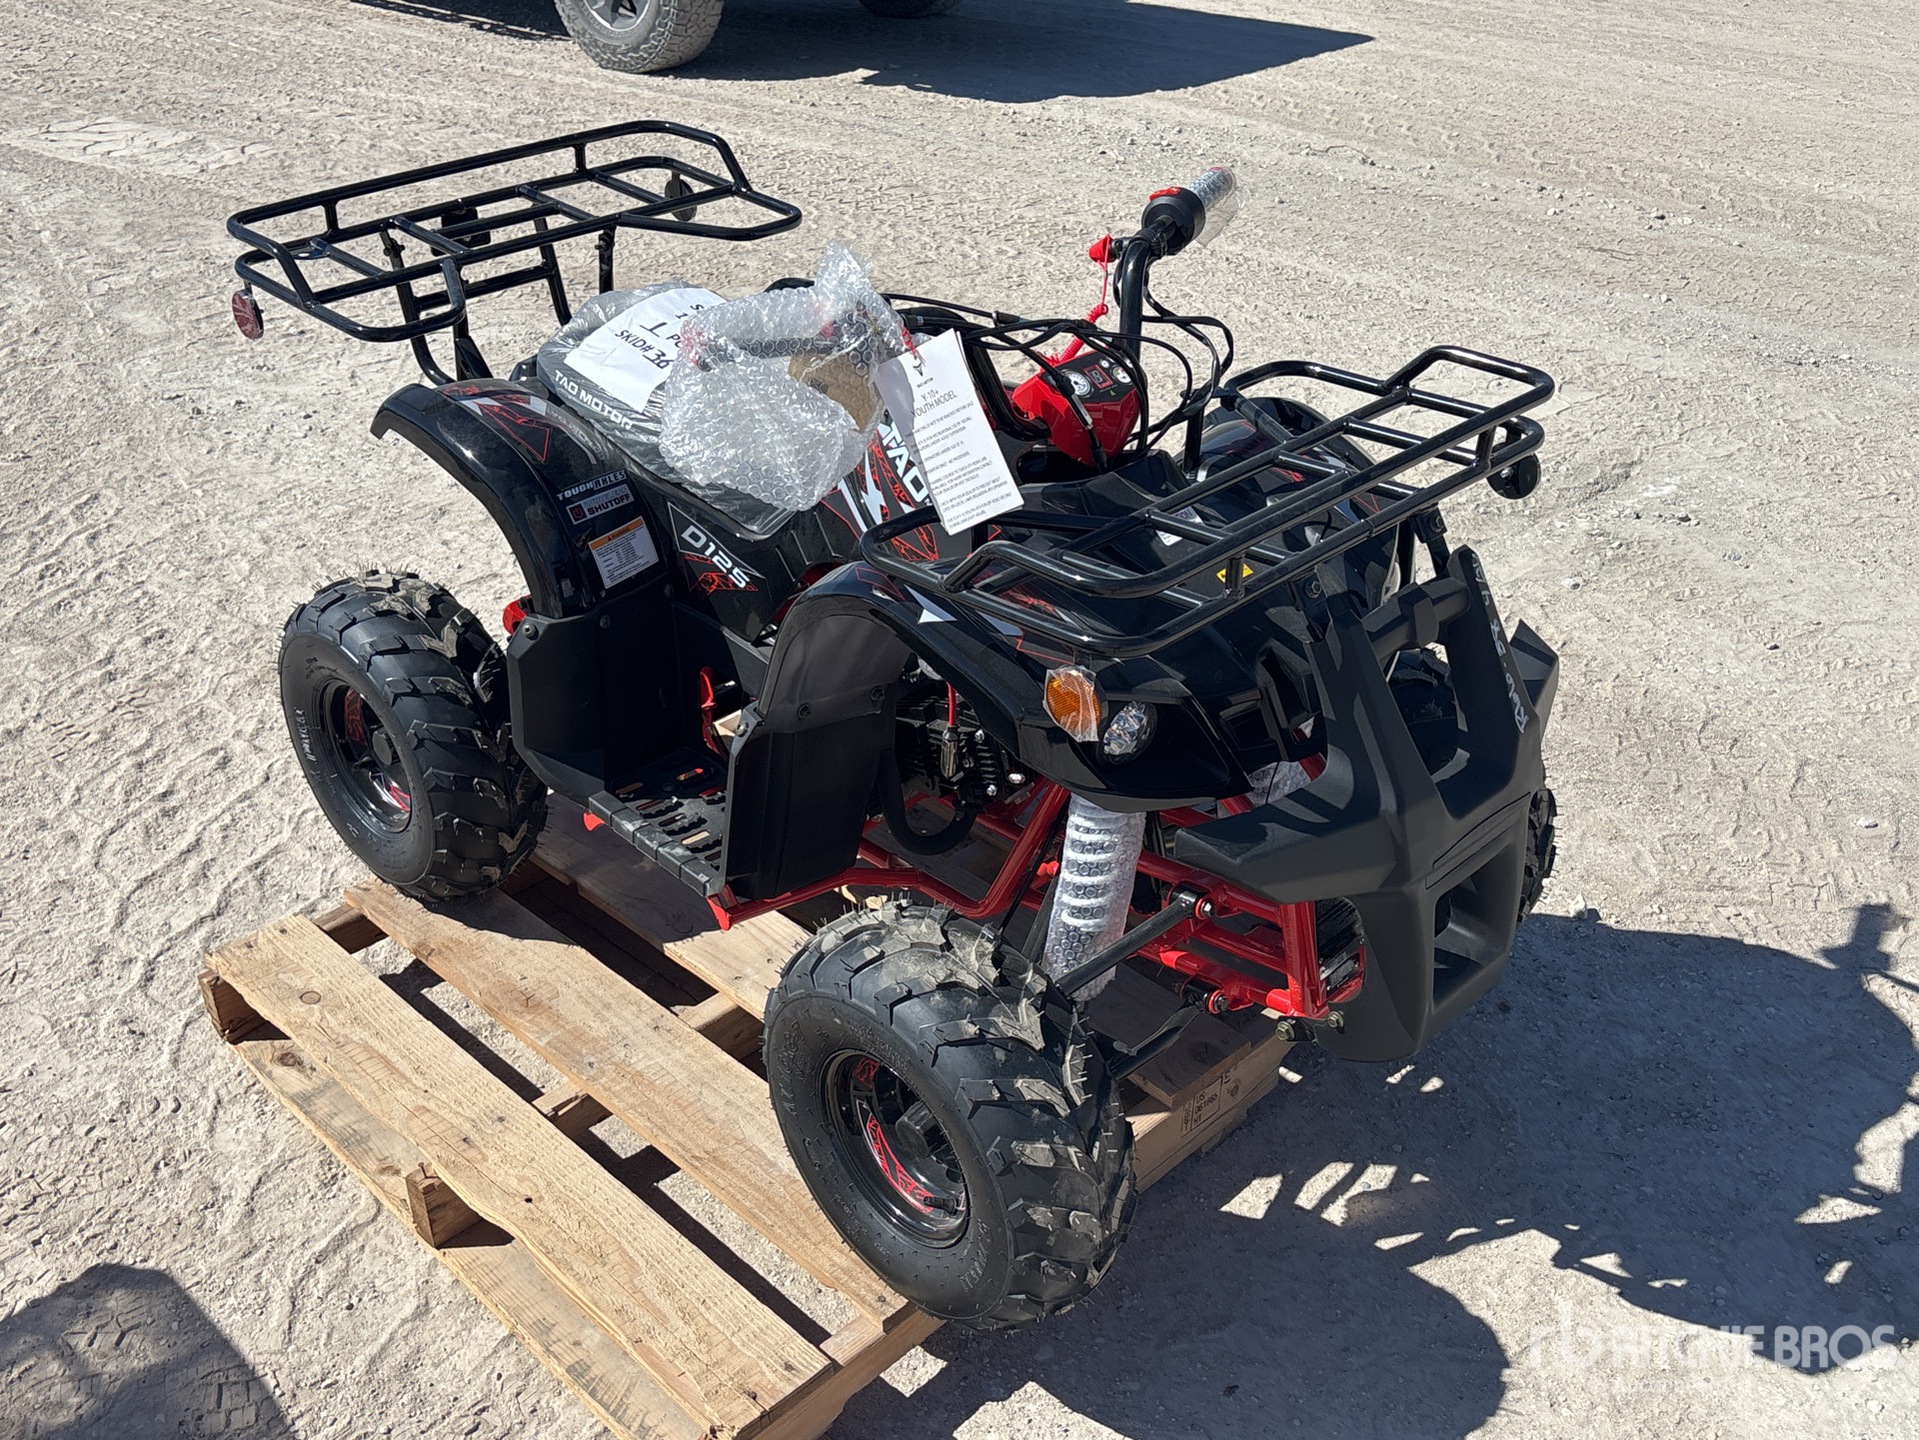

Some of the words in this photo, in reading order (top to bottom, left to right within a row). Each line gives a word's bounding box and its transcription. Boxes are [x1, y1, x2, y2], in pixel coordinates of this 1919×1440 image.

[554, 369, 579, 396] TAO
[579, 388, 634, 431] MOTOR
[910, 401, 936, 418] YOUTH
[934, 389, 958, 408] MODEL
[882, 421, 929, 503] TAO
[587, 493, 631, 516] SHUTOFF
[681, 524, 751, 589] D125
